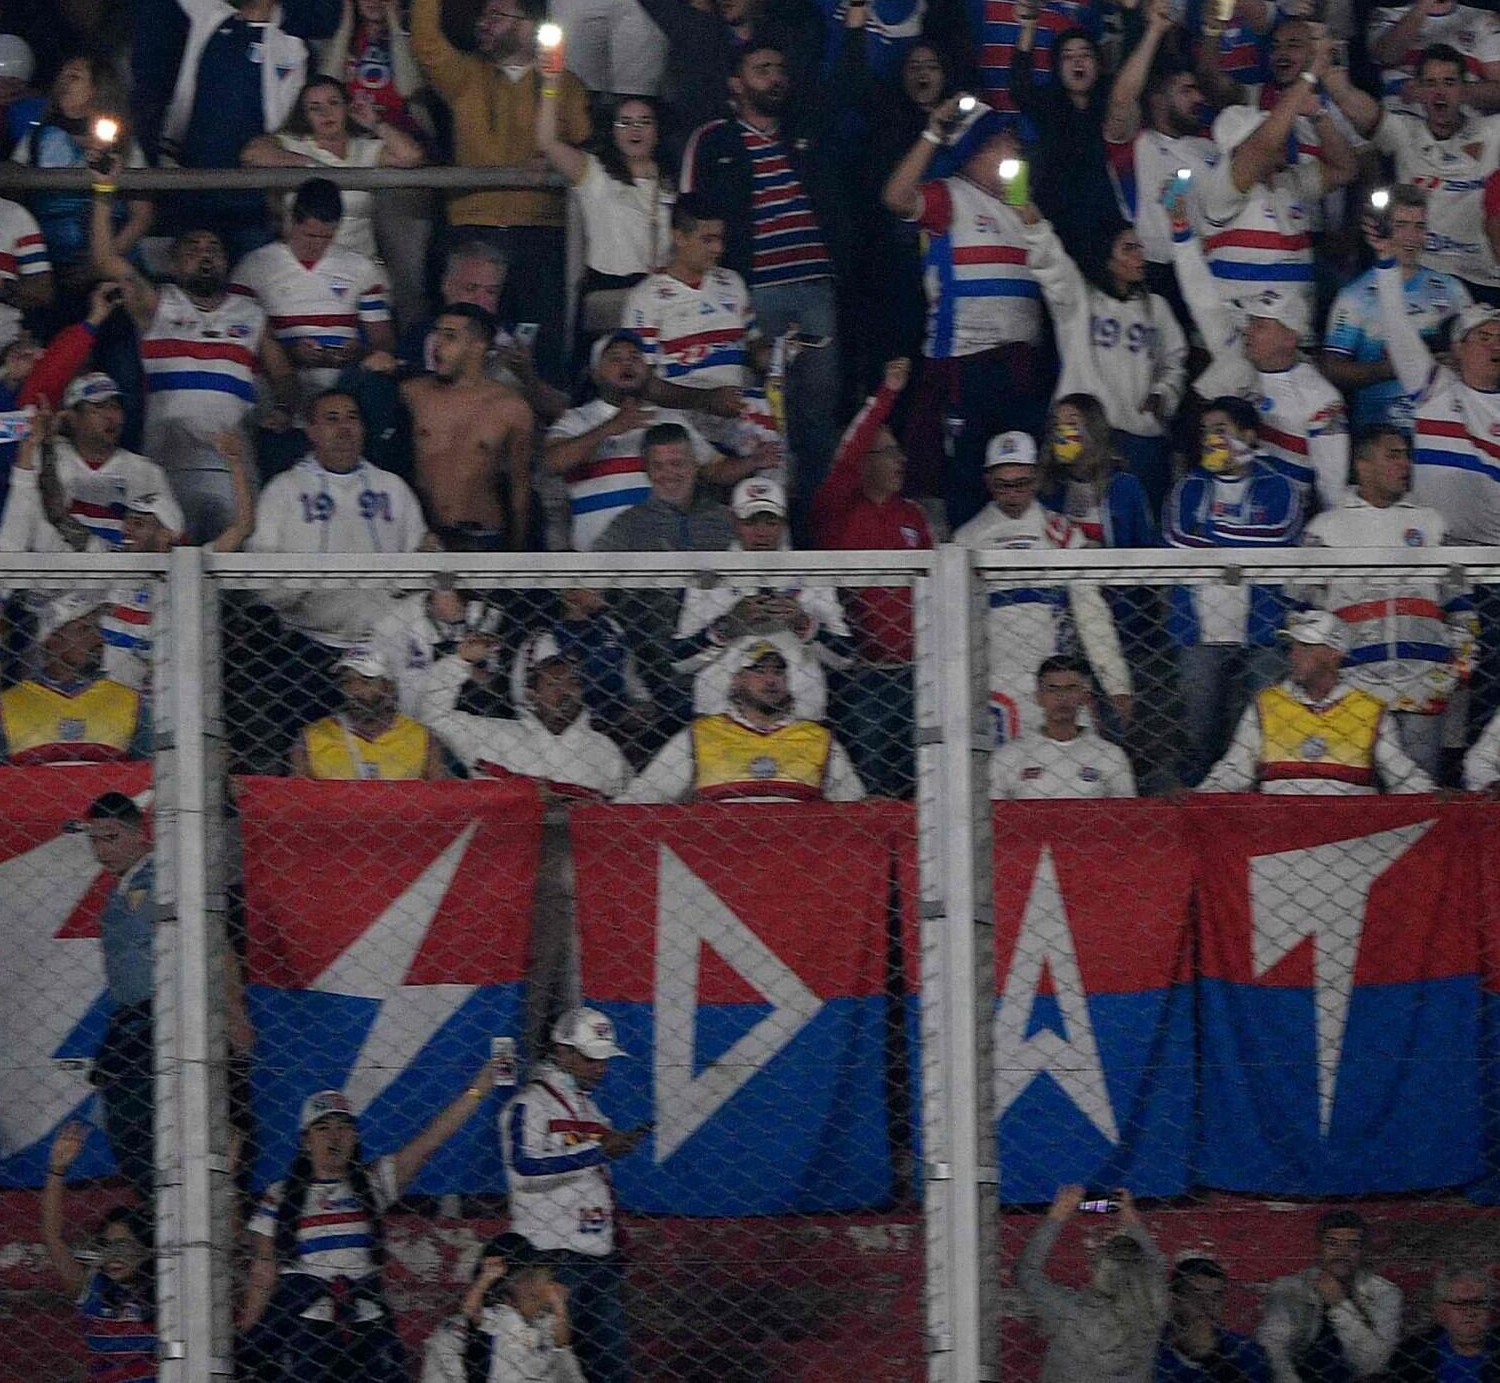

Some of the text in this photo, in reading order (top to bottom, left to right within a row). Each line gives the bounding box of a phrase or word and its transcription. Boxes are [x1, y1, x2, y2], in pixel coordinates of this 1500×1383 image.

[1090, 314, 1121, 349] 19
[301, 488, 394, 522] 19 91
